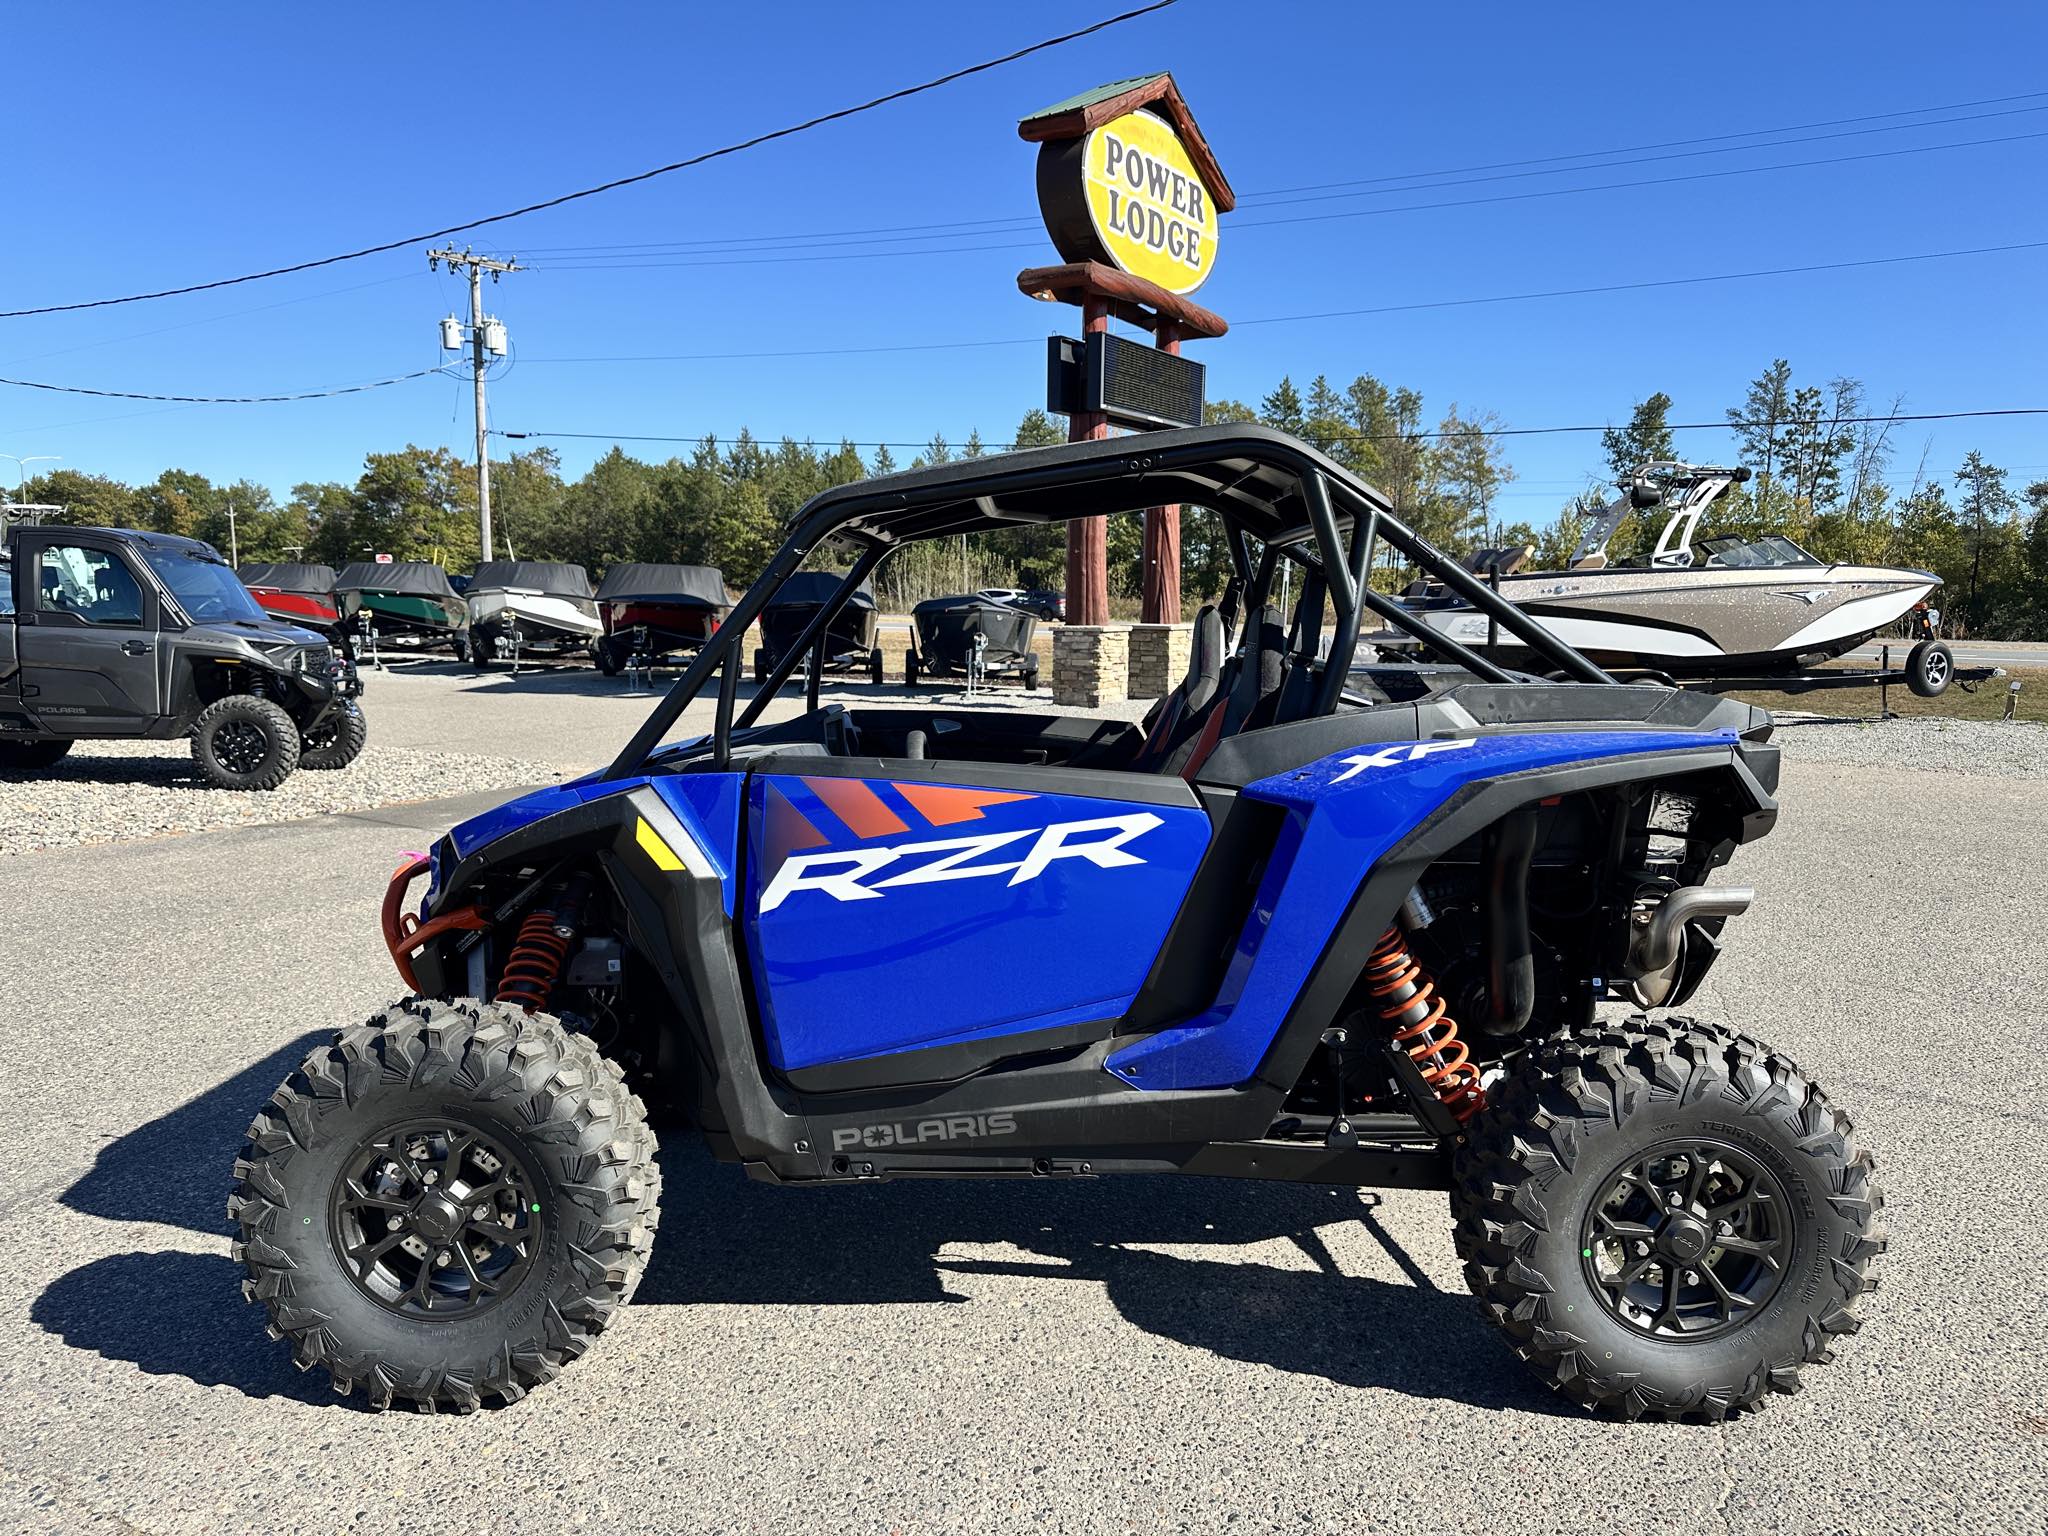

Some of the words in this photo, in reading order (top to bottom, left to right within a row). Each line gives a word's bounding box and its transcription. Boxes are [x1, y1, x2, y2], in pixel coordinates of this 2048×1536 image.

[1106, 135, 1204, 223] POWER
[1109, 189, 1200, 267] LODGE
[37, 706, 87, 714] POLARIS
[1327, 738, 1477, 785] XP
[759, 812, 1165, 913] RZR
[832, 1113, 1018, 1151] POLARIS
